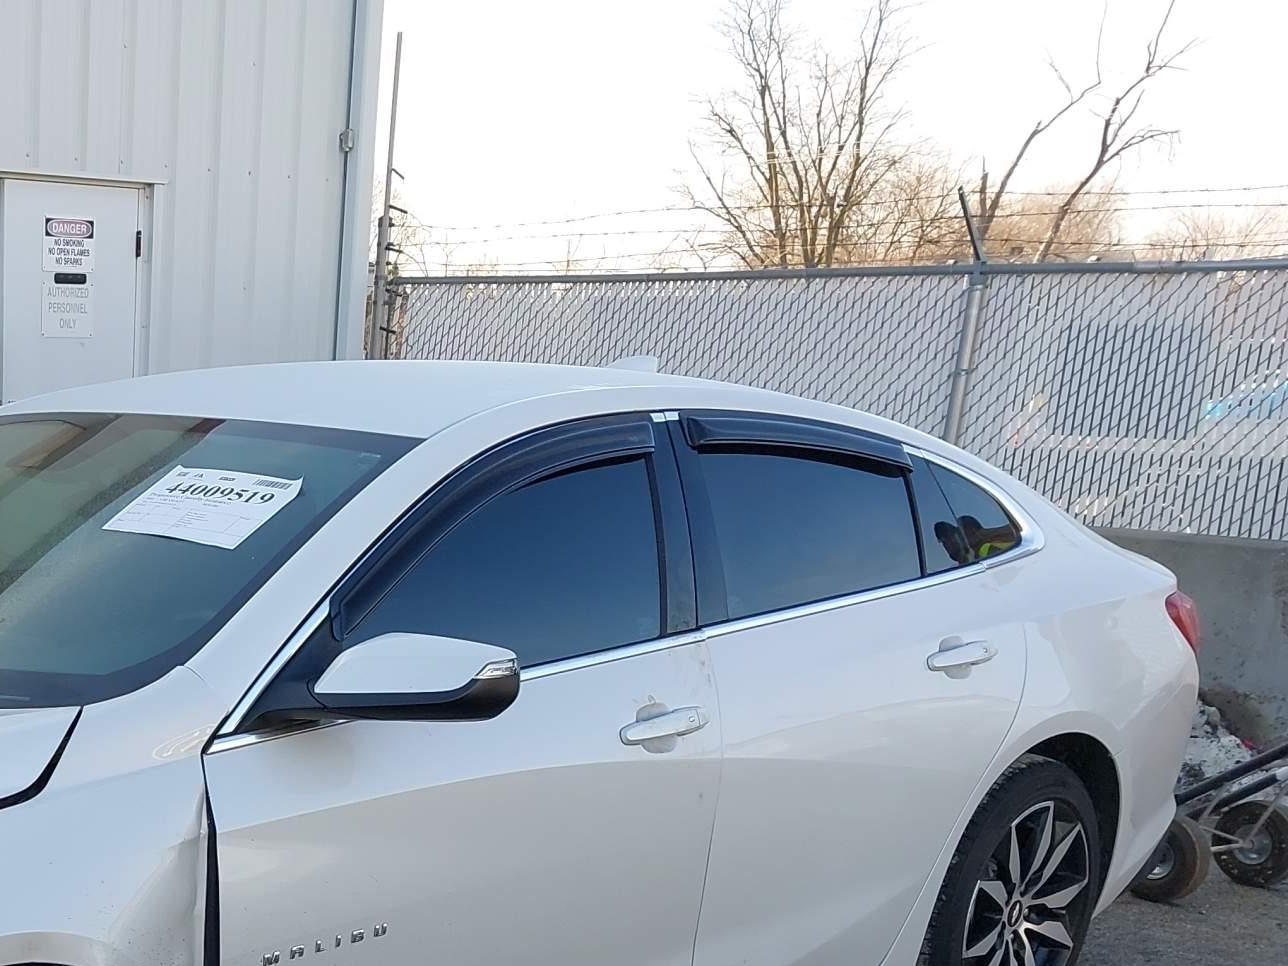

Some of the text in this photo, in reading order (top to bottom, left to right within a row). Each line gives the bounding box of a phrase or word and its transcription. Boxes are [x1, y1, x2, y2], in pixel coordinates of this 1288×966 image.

[52, 222, 87, 234] DANGER
[54, 239, 84, 248] NO SMOKING
[48, 247, 90, 257] NO OPEN FLAMES
[55, 257, 83, 266] NO SPARKS
[47, 287, 89, 299] AUTHORIZED
[48, 302, 88, 314] PERSONNEL
[59, 318, 77, 329] ONLY
[165, 481, 275, 505] 44009519
[262, 922, 389, 966] MALIBU
